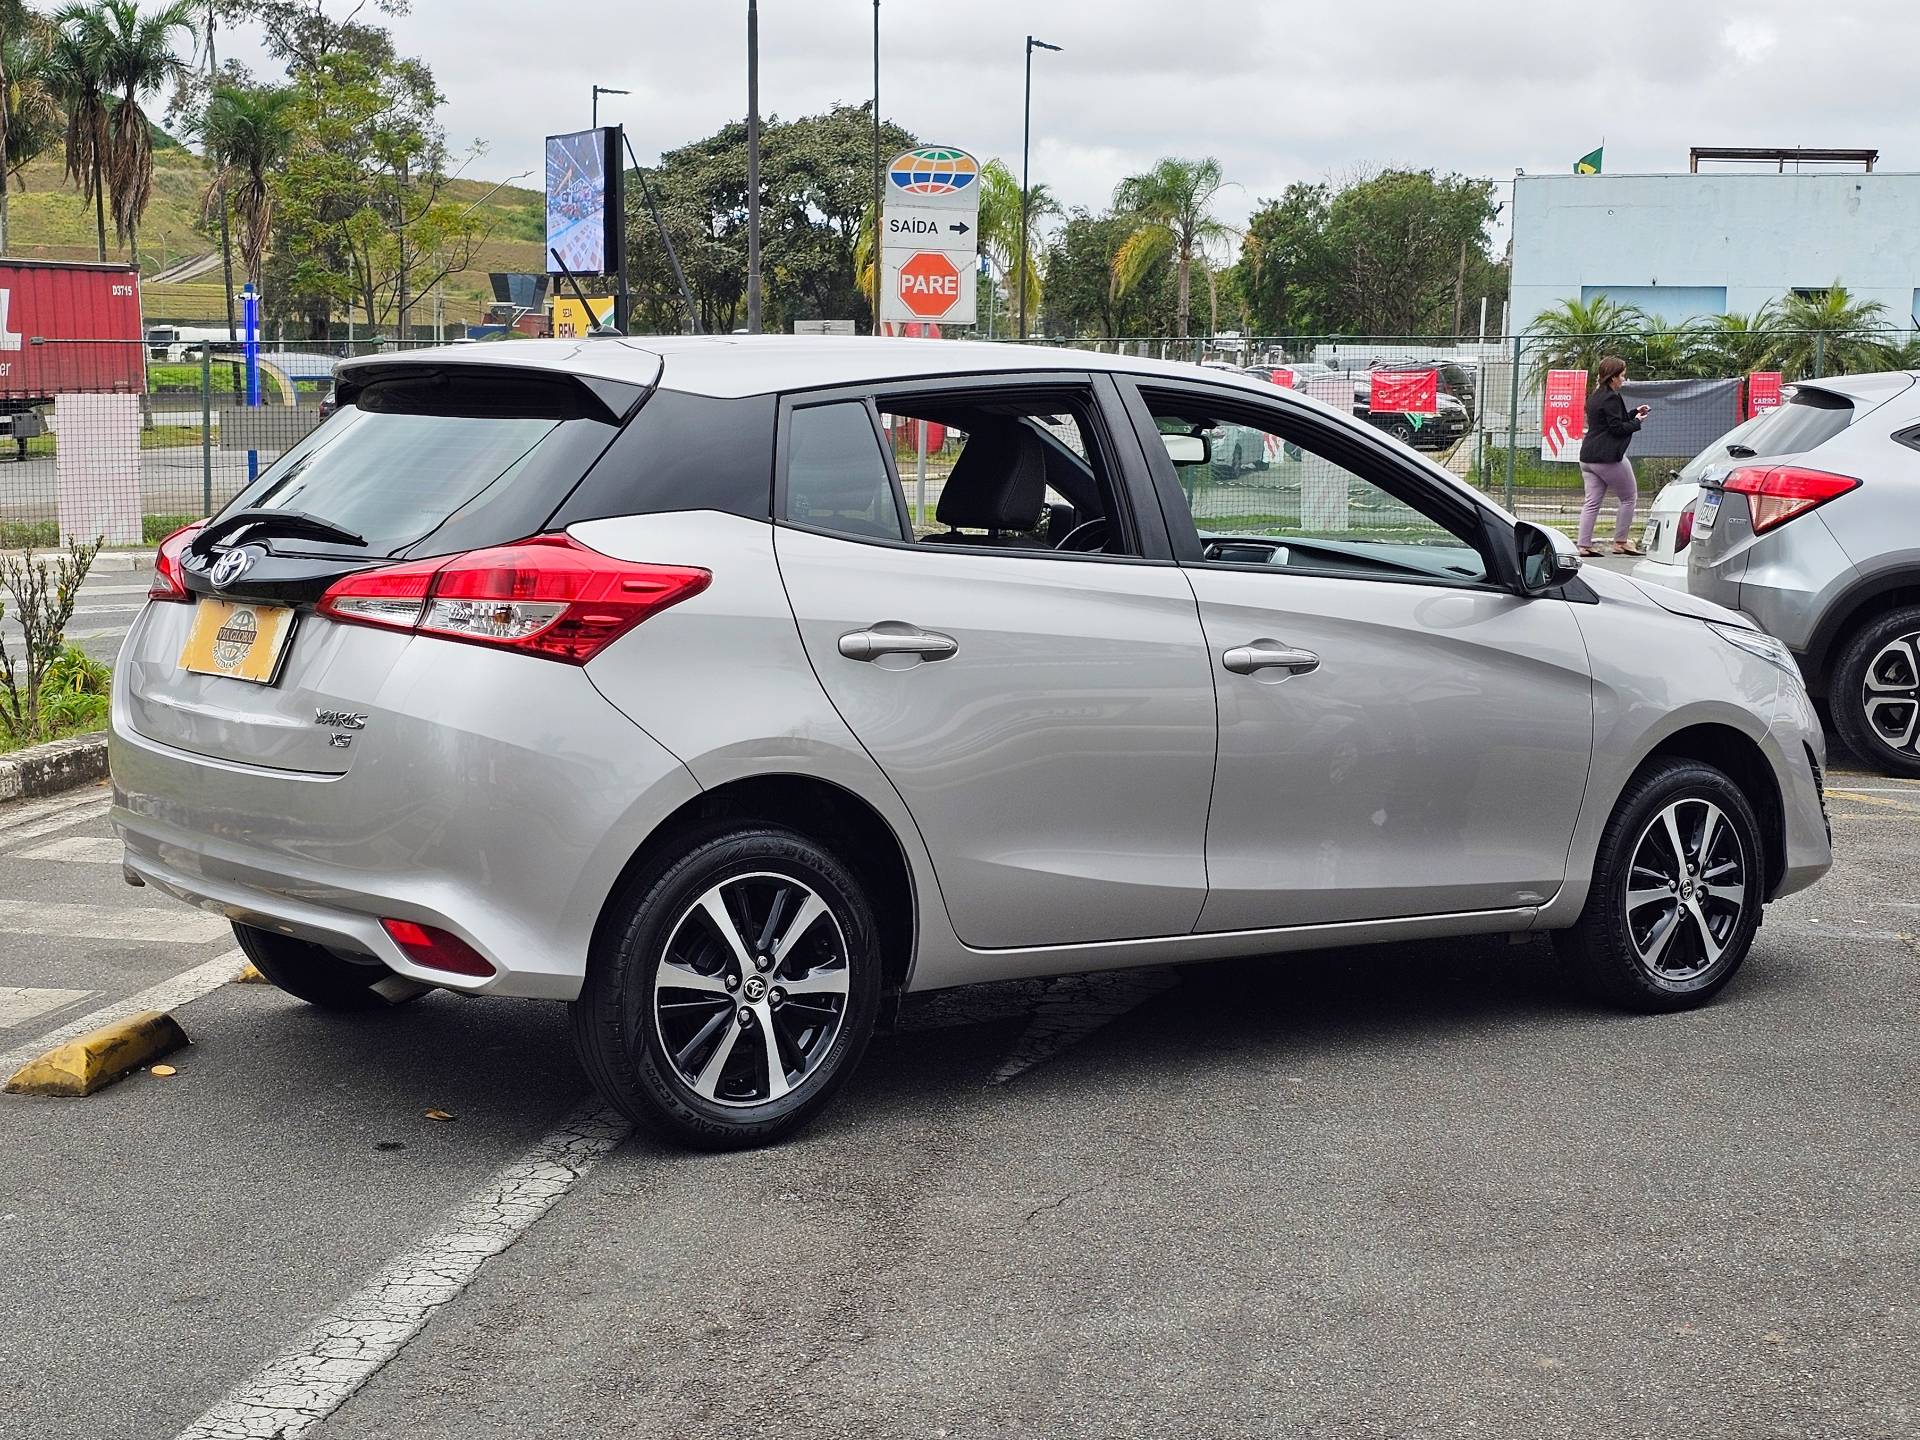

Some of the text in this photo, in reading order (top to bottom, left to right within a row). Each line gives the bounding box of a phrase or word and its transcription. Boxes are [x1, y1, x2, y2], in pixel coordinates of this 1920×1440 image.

[890, 217, 939, 234] SAÍDA
[112, 285, 132, 296] D3715
[901, 274, 957, 295] PARE
[219, 628, 256, 643] VIA GLOBAL
[315, 707, 368, 730] YARIS
[329, 732, 352, 748] XS
